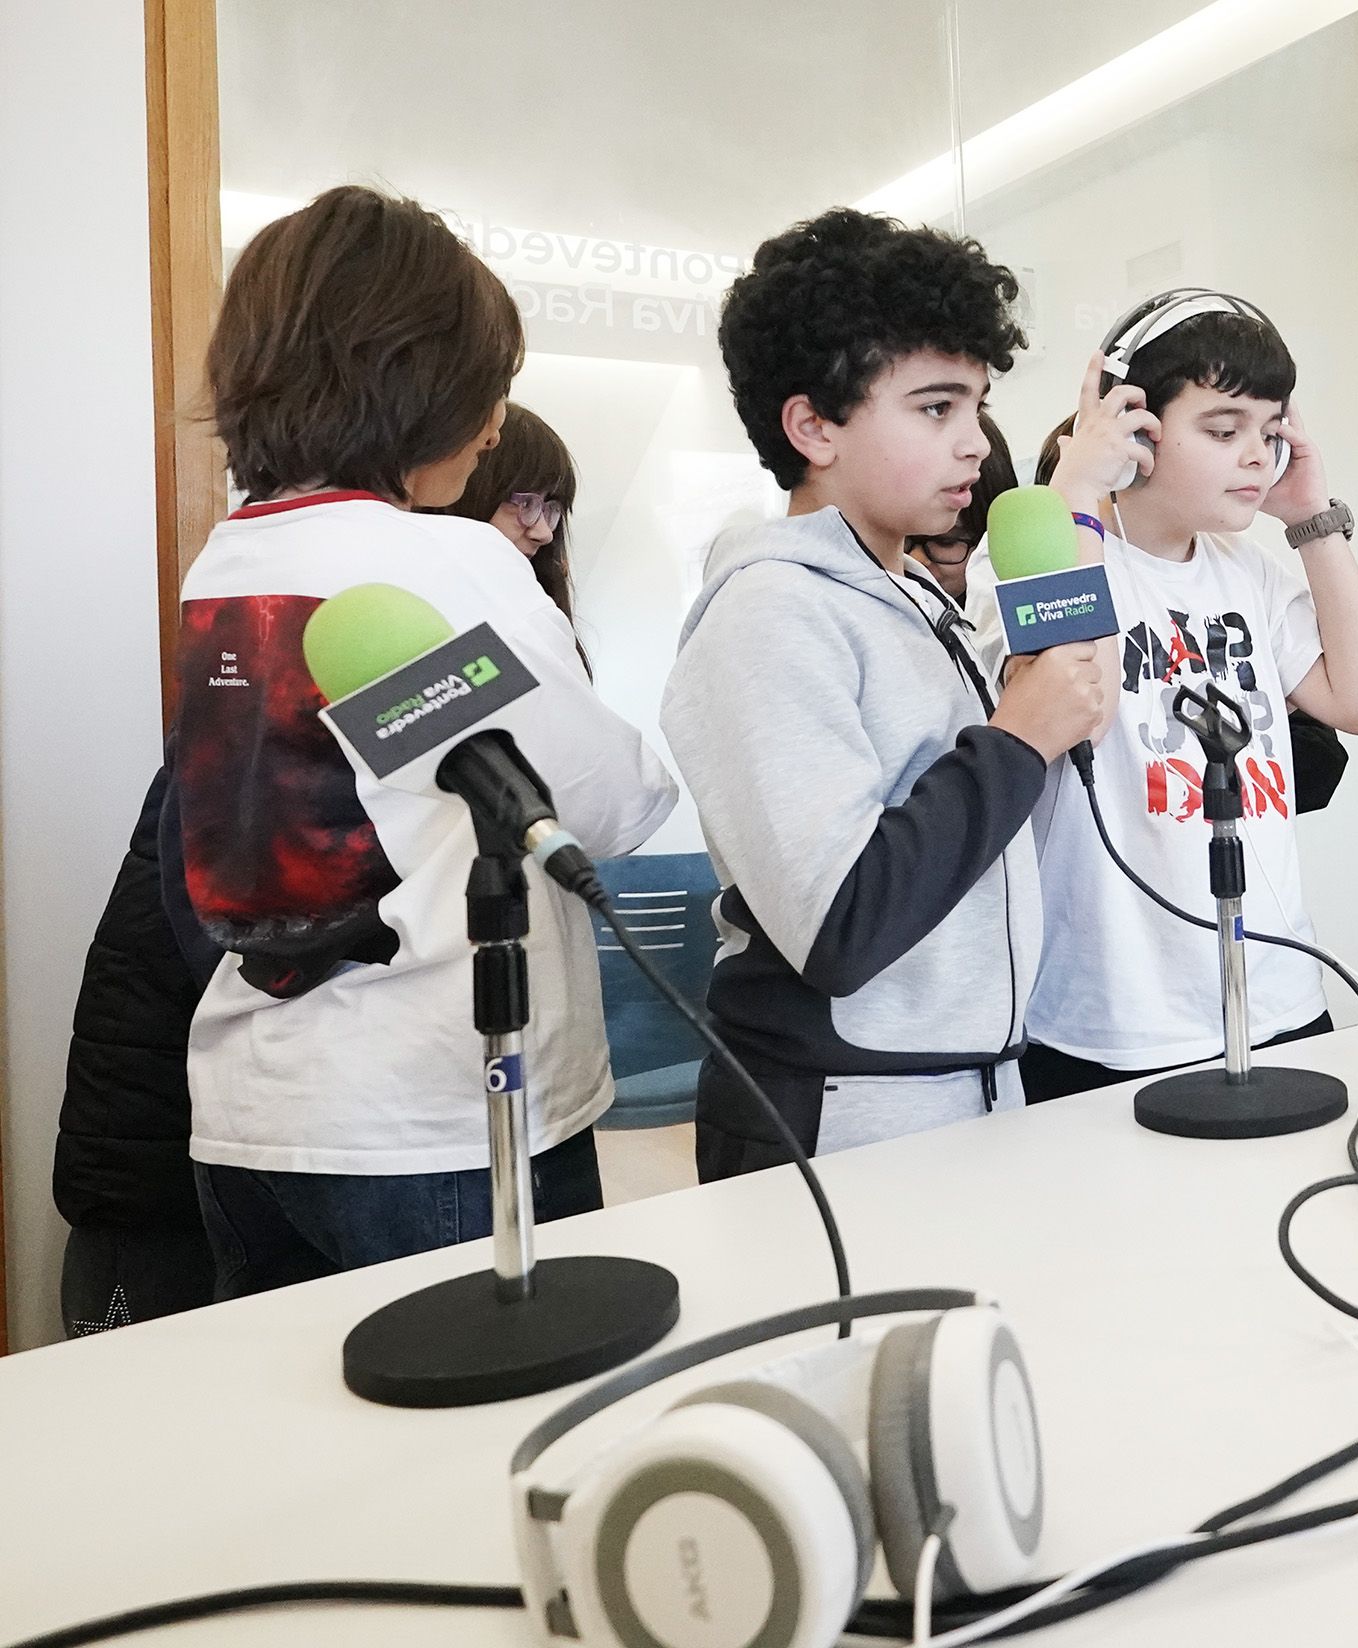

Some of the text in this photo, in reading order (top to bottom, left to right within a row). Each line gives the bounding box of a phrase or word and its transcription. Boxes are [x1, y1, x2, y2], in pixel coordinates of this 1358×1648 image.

[1036, 592, 1097, 612] Pontevedra
[1039, 604, 1094, 622] Viva Radio
[221, 651, 237, 661] One
[221, 664, 238, 674] Last
[209, 677, 250, 686] Adventure.
[376, 674, 463, 725] Viva Radio
[375, 681, 472, 740] Pontevedra
[485, 1057, 508, 1092] 6
